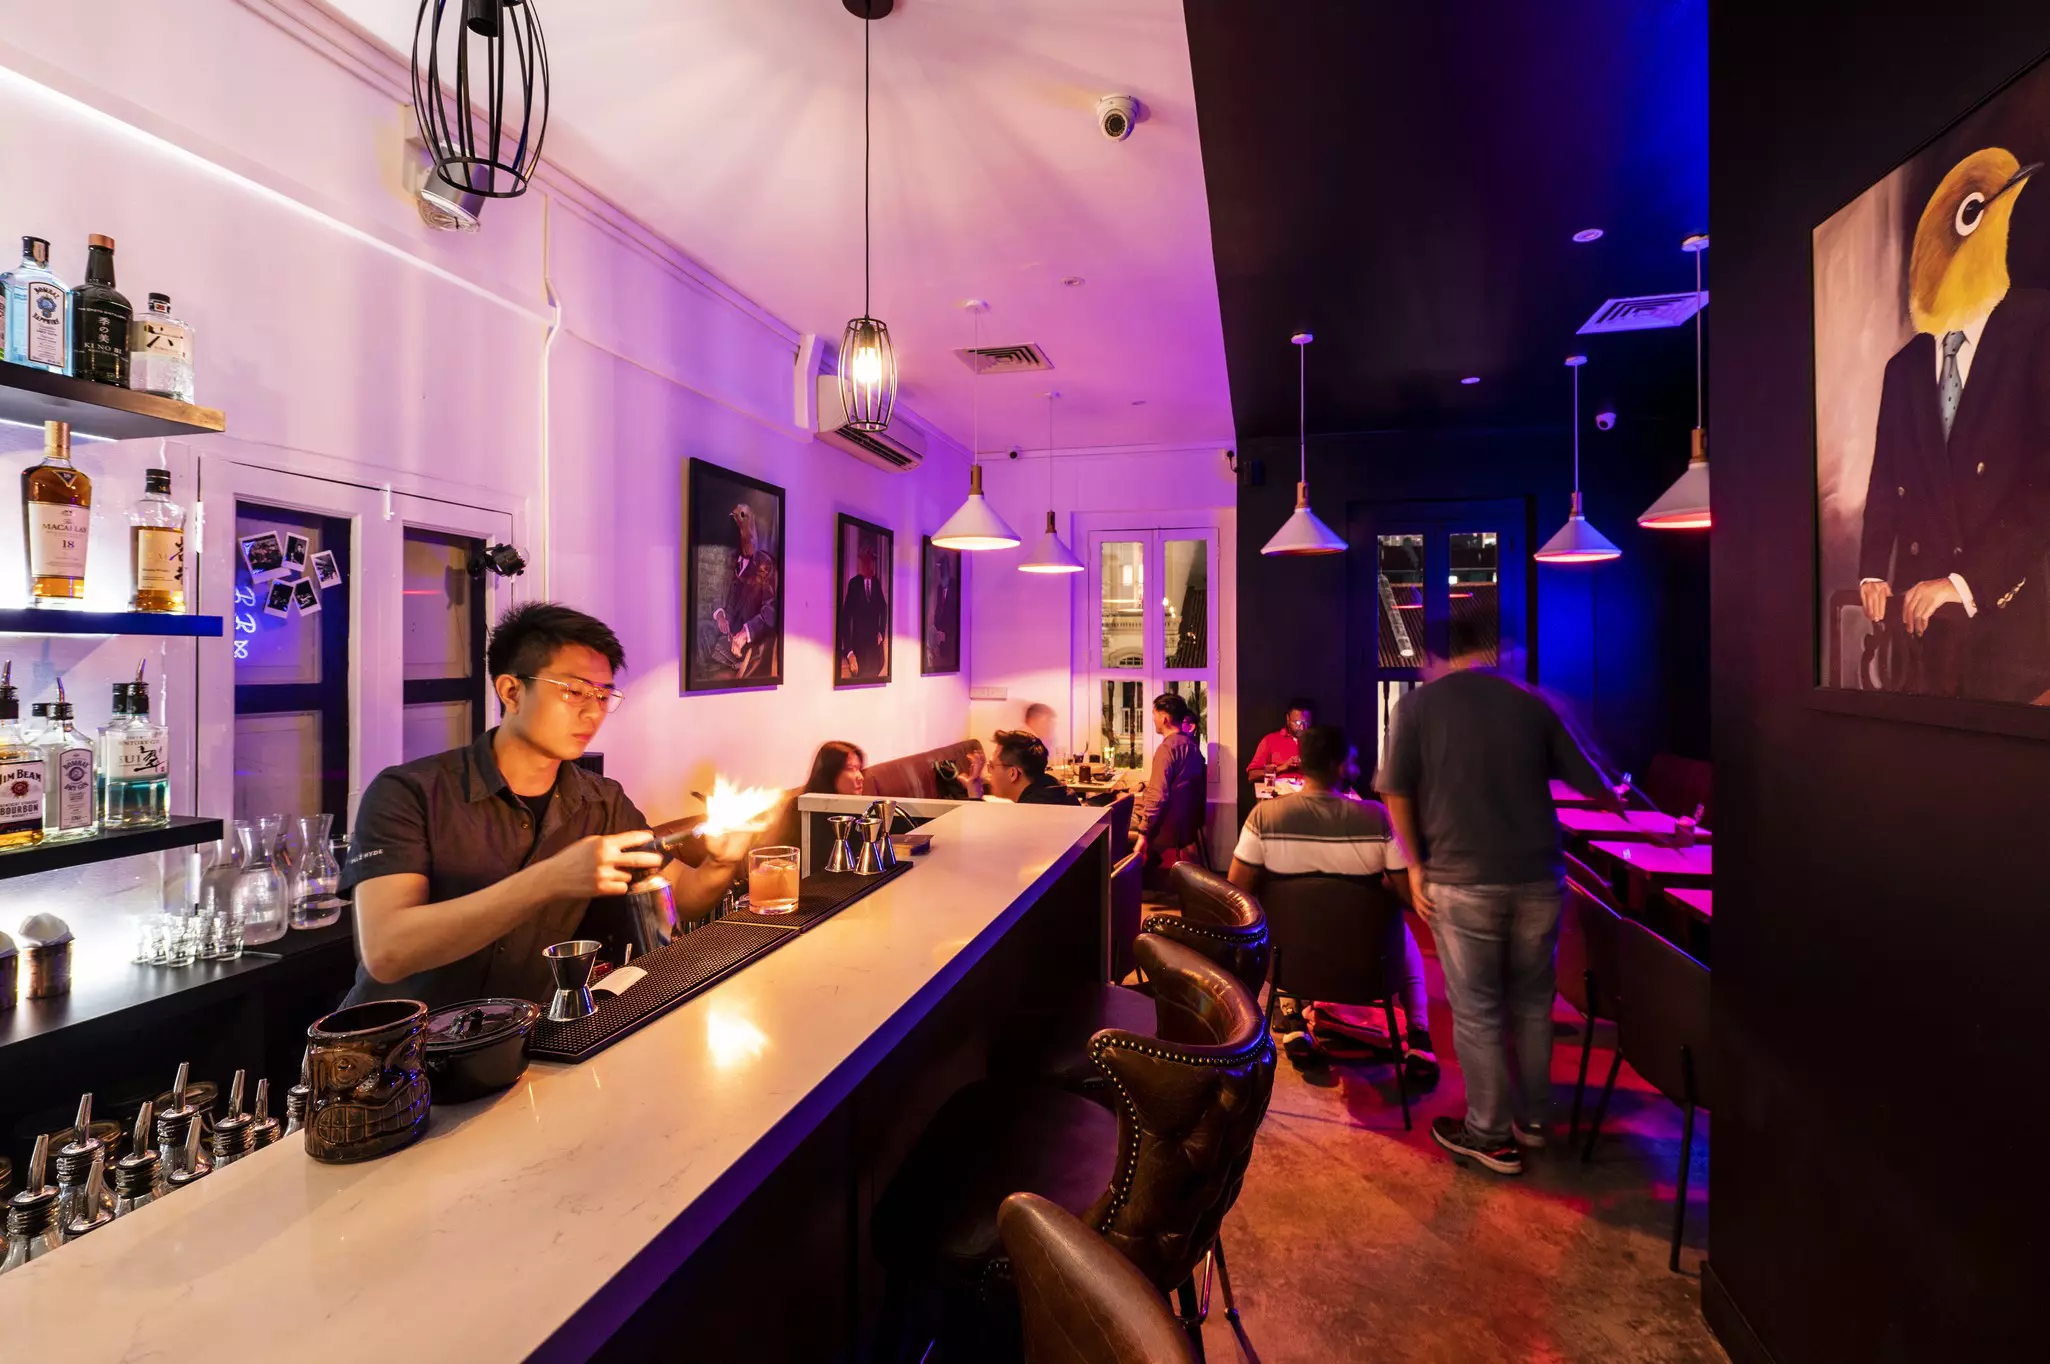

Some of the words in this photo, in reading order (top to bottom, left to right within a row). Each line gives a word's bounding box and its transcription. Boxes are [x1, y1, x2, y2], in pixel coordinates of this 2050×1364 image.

[63, 540, 75, 548] 18
[62, 760, 89, 770] BOMBAY
[16, 769, 42, 782] BEAM
[0, 804, 38, 815] BOURBON
